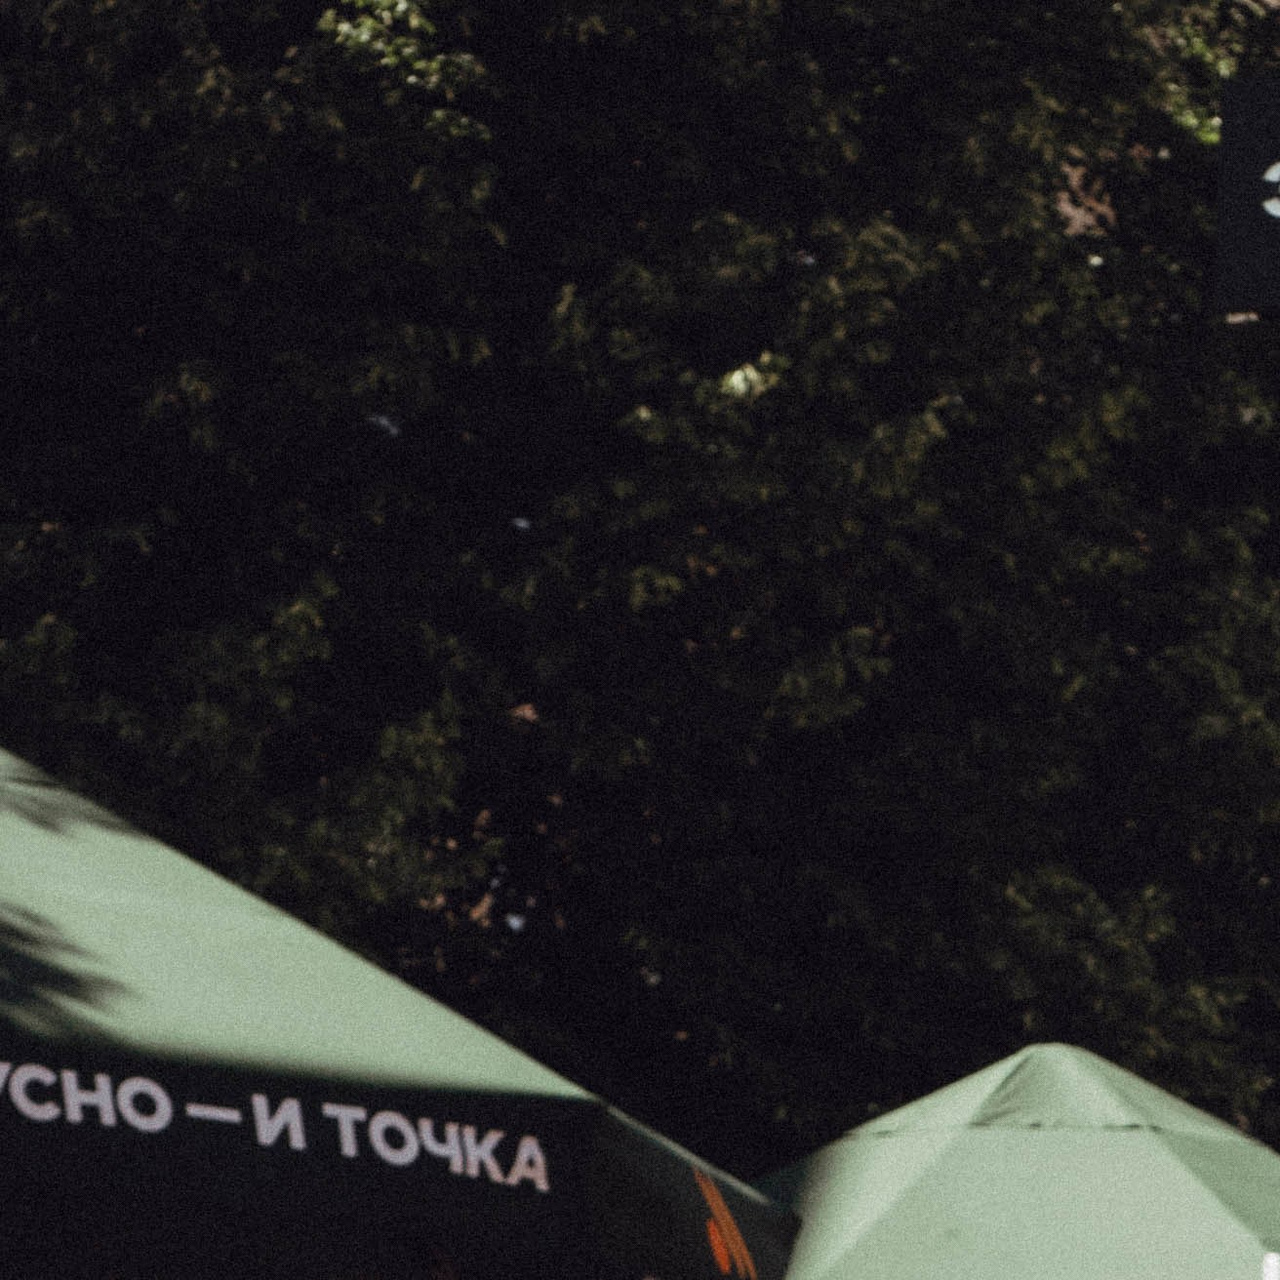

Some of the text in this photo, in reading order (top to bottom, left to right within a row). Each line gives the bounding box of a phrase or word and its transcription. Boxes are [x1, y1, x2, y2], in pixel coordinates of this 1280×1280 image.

[0, 1062, 173, 1133] СНО
[251, 1093, 307, 1151] И
[321, 1102, 551, 1192] ТОЧКА
